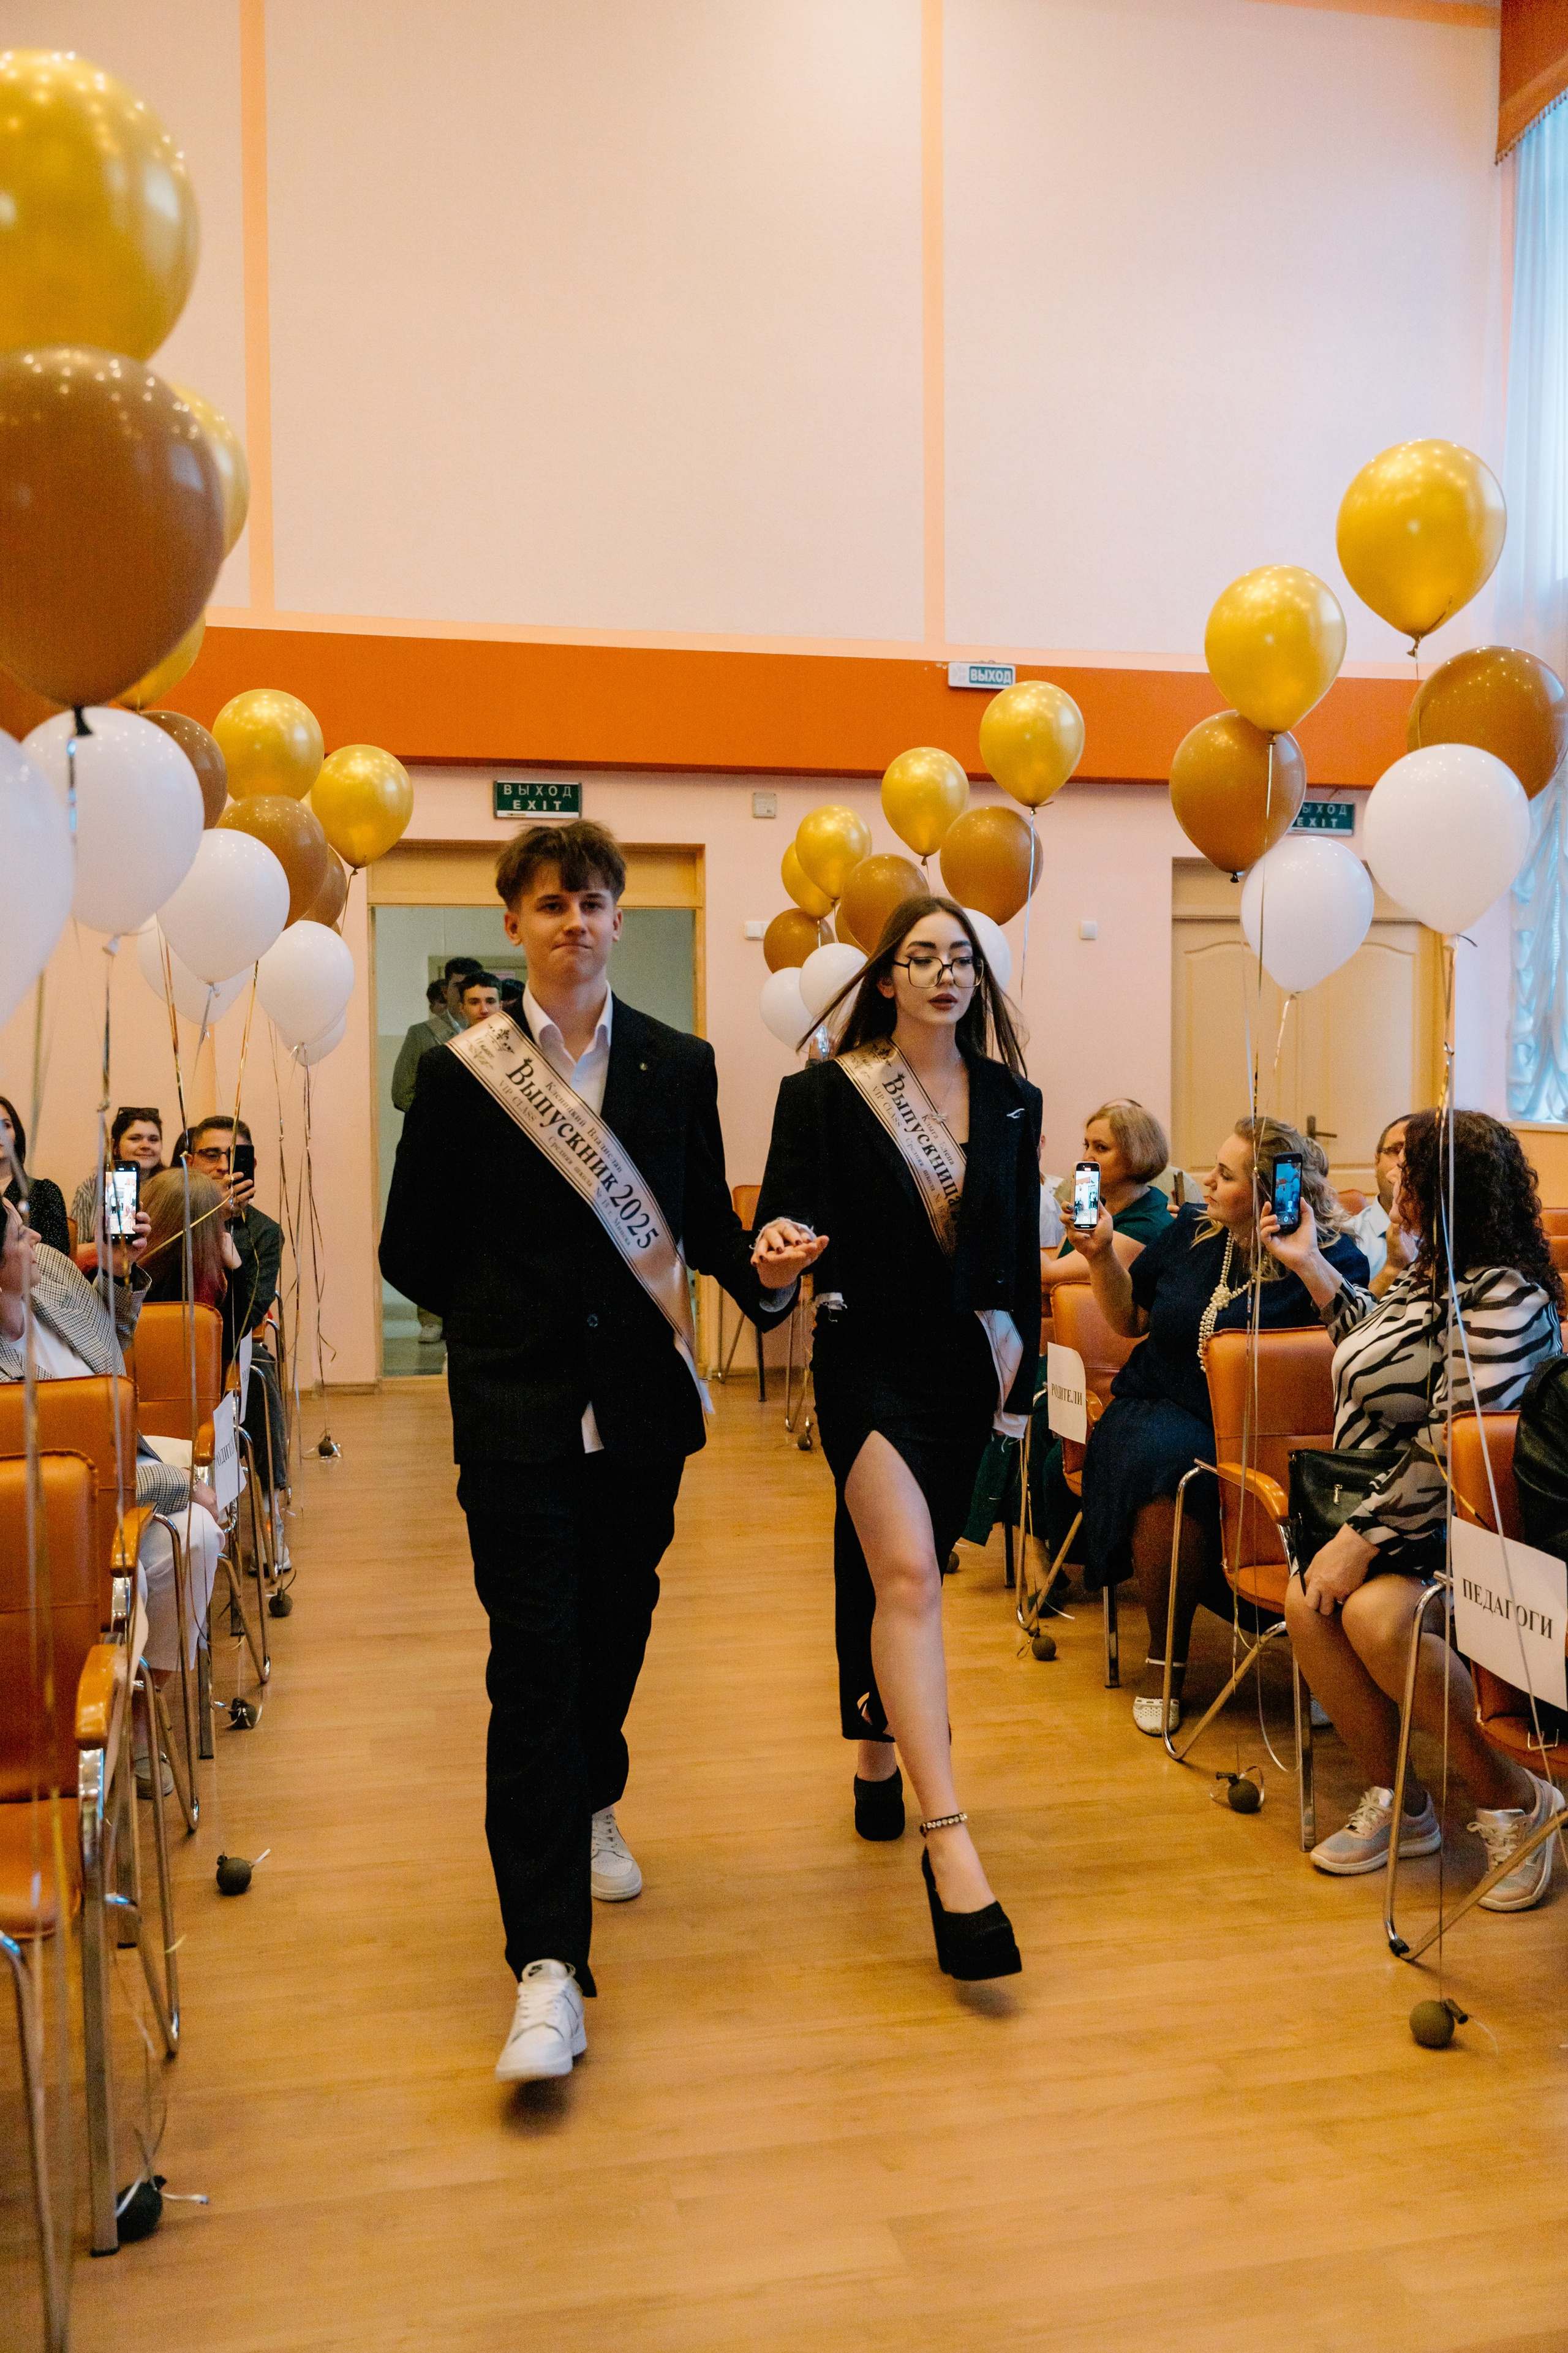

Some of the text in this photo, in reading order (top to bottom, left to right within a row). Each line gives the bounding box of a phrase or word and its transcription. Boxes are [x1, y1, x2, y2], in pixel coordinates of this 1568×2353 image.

[970, 668, 1012, 685] ВЫХОД
[503, 784, 571, 798] ВЫХОД
[513, 799, 562, 810] EXIT
[1297, 817, 1338, 828] EXIT
[1302, 804, 1347, 816] ЫХОД
[499, 1080, 537, 1122] VIP CLASS
[872, 1086, 902, 1127] VIP CLASS
[505, 1062, 660, 1248] Выпускник 2025
[587, 1127, 622, 1173] Владислав
[882, 1077, 962, 1207] Выпускница
[940, 1141, 955, 1165] Елена
[906, 1138, 924, 1167] Средняя
[923, 1169, 936, 1192] школа
[1051, 1383, 1082, 1405] РОДИТЕЛИ
[1463, 1577, 1553, 1640] ПЕДАГОГИ
